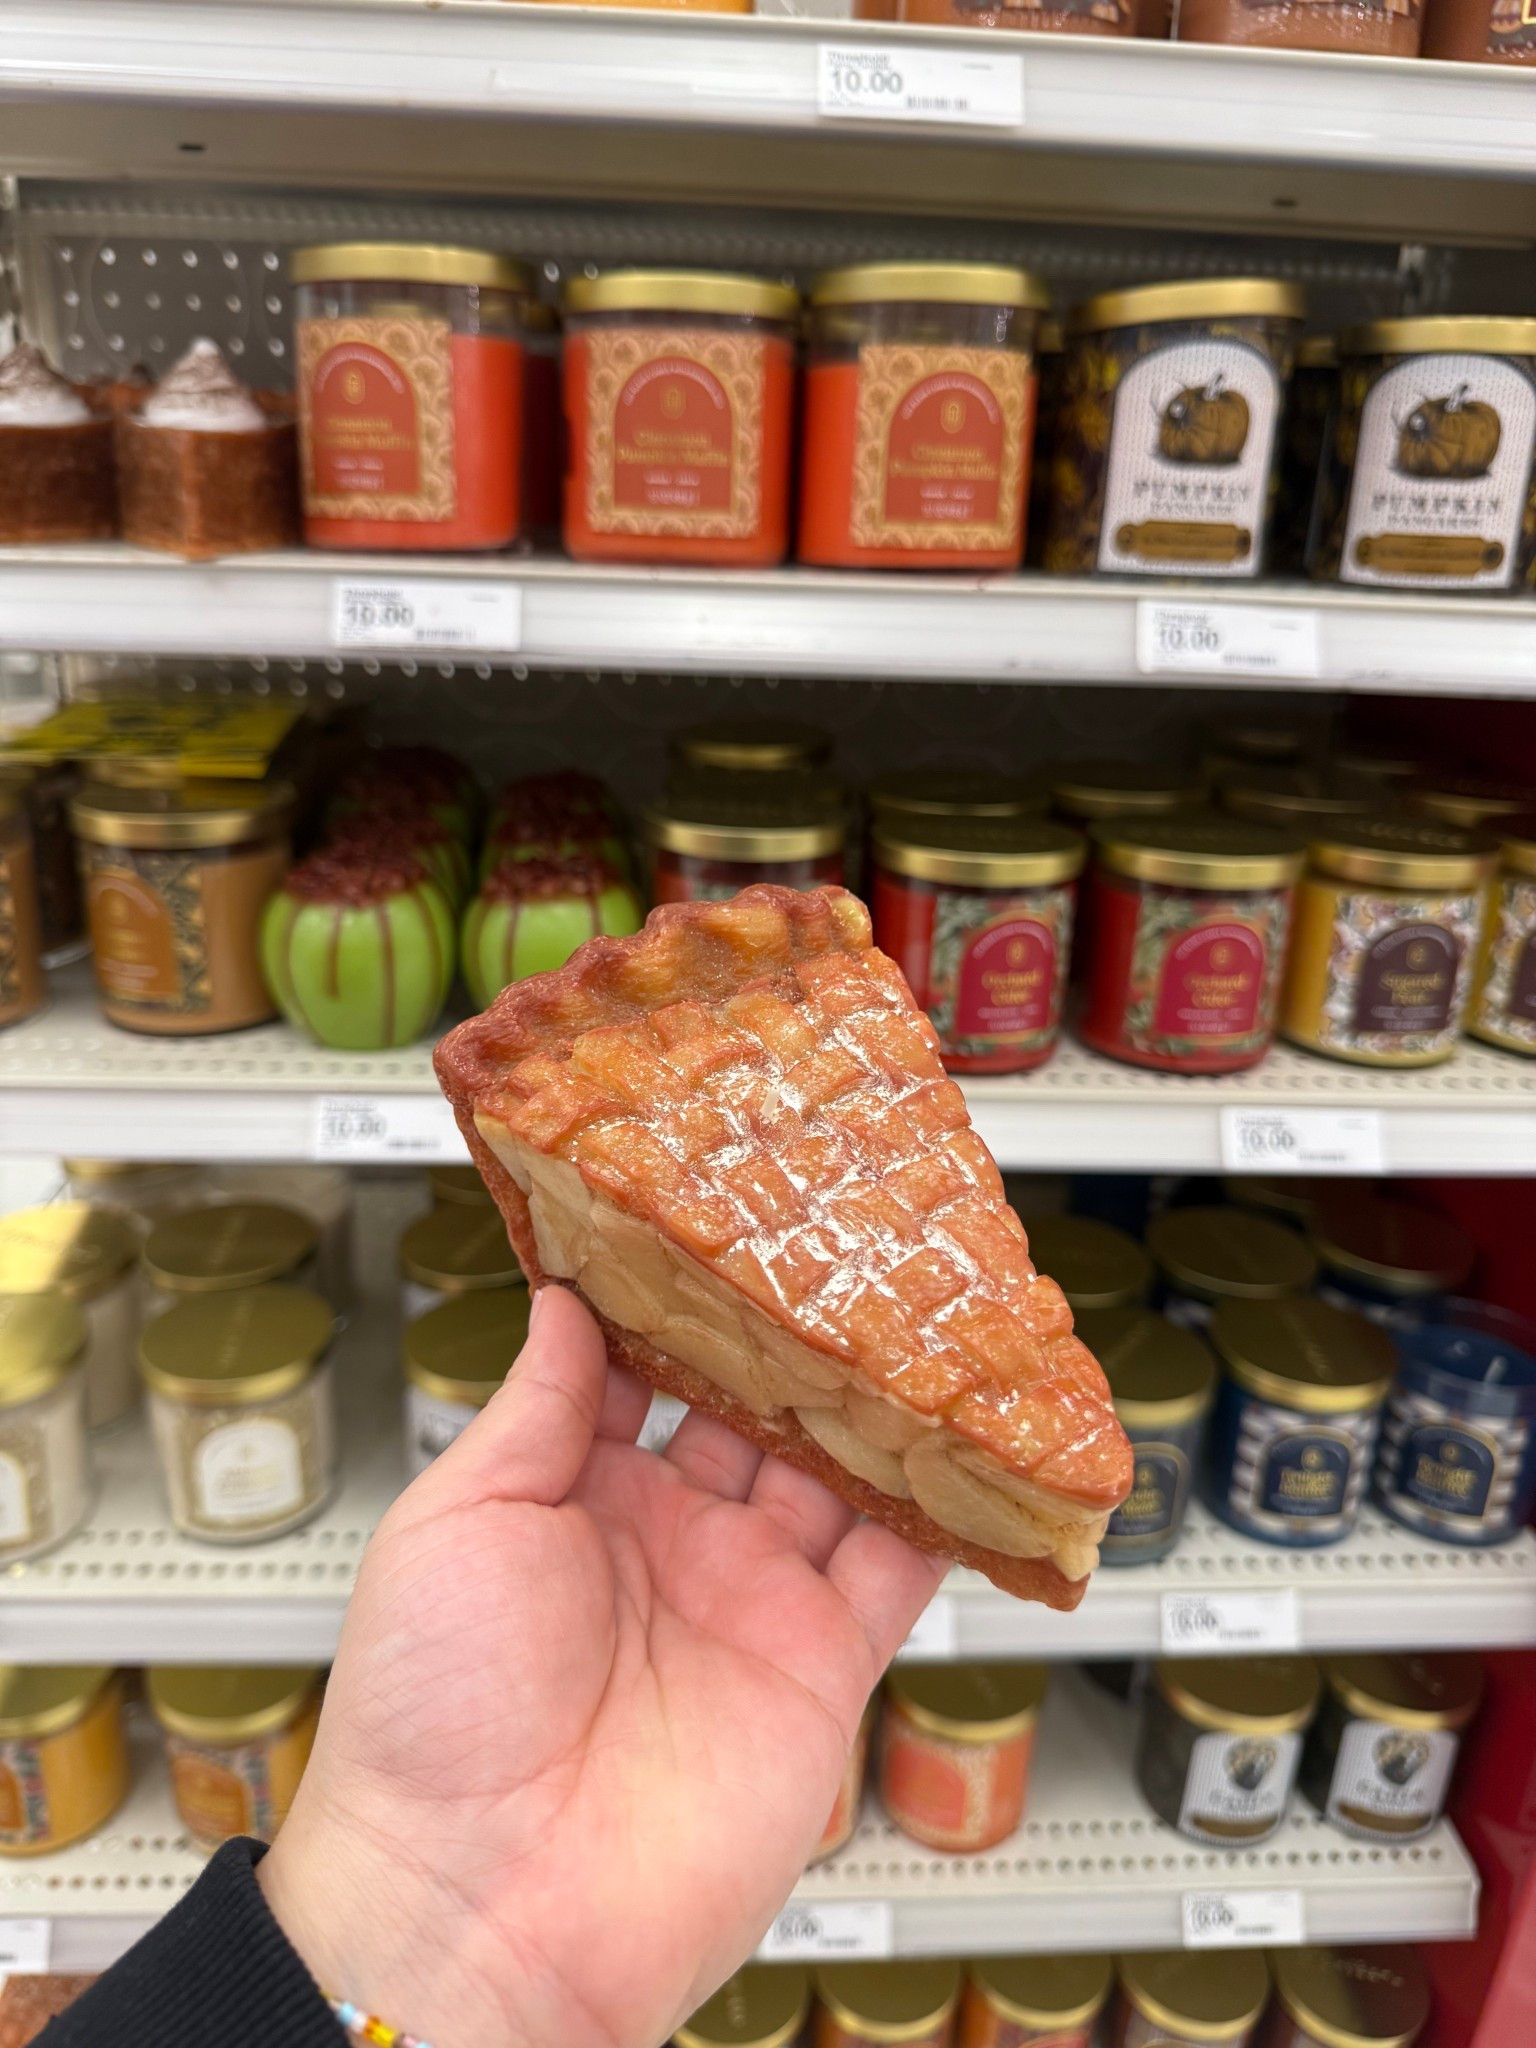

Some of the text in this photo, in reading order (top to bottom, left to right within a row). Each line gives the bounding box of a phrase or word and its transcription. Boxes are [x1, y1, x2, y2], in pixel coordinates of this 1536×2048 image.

[831, 70, 904, 94] 10.00
[1133, 481, 1249, 501] PUMPKIN
[1373, 494, 1501, 514] PUMPKIN
[346, 603, 416, 628] 10.00
[1159, 628, 1221, 652] 10.00
